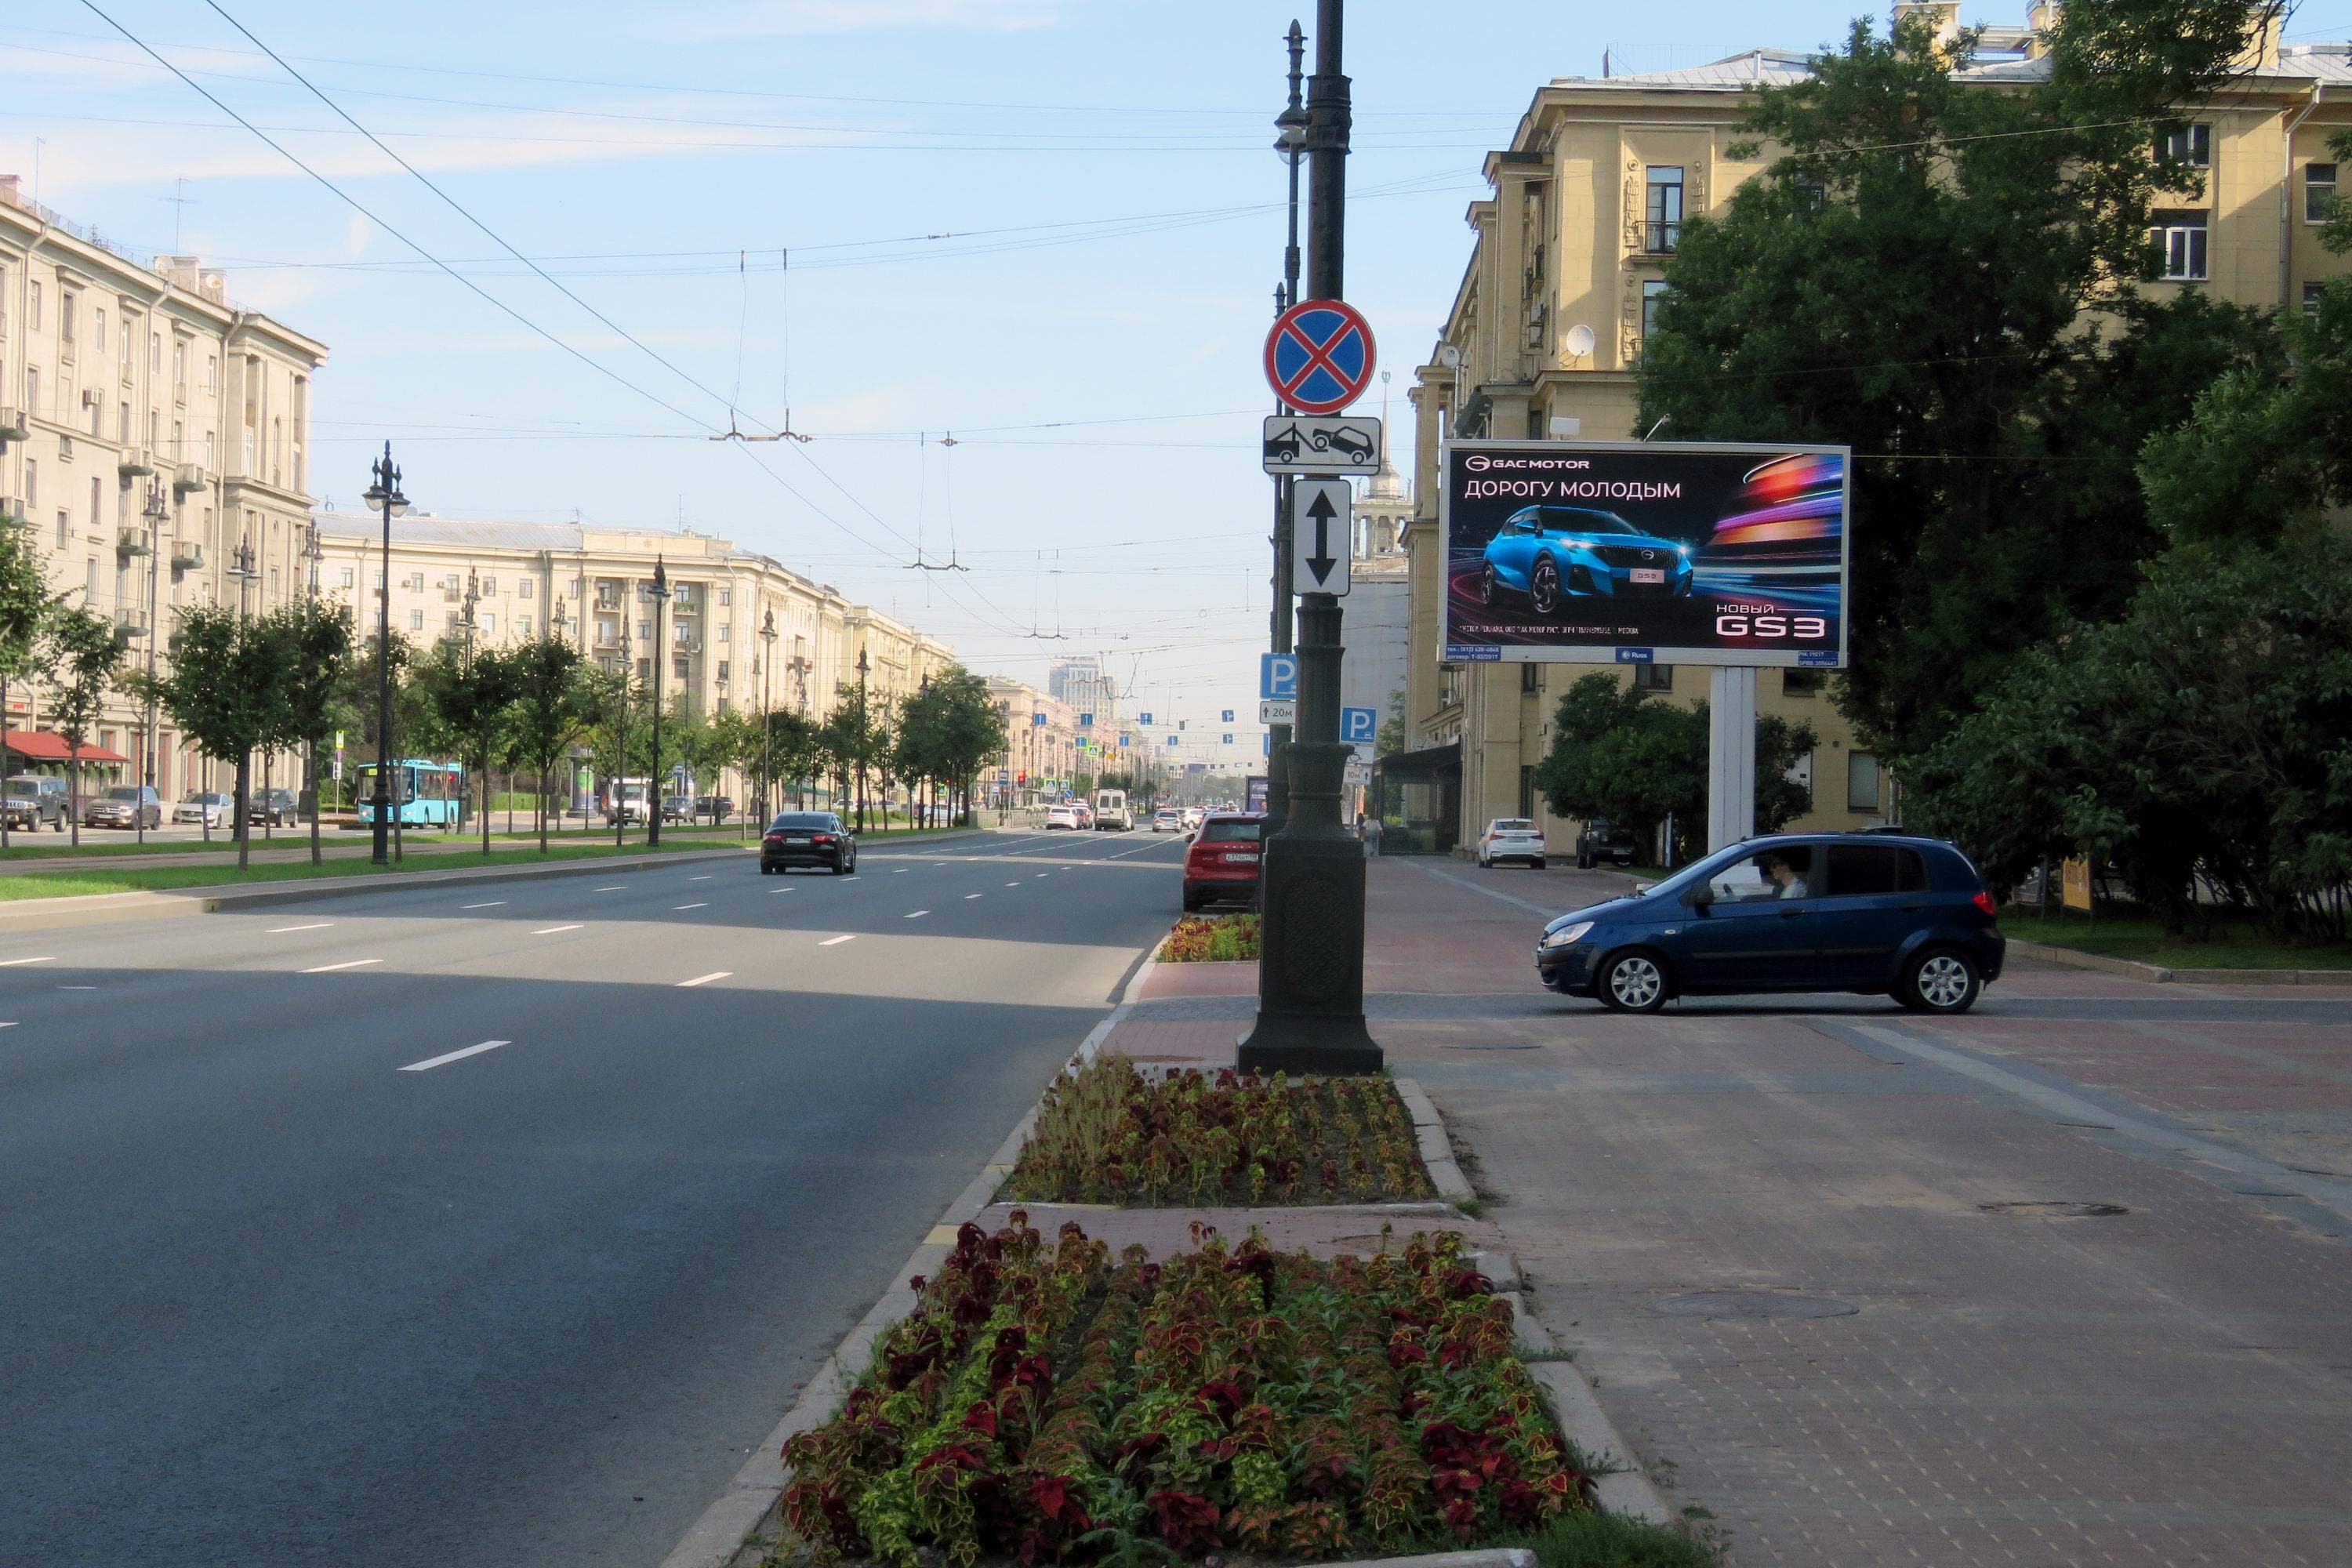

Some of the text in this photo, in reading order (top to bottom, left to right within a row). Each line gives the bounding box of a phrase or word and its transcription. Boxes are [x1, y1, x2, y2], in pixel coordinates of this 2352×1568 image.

[1492, 459, 1590, 470] GAC MOTOR
[1465, 480, 1681, 501] ДОРОГУ МОЛОДЫМ
[1716, 604, 1774, 614] НОВЫЙ
[1716, 615, 1825, 638] GS3
[1272, 708, 1293, 717] 20м
[1350, 711, 1370, 739] P
